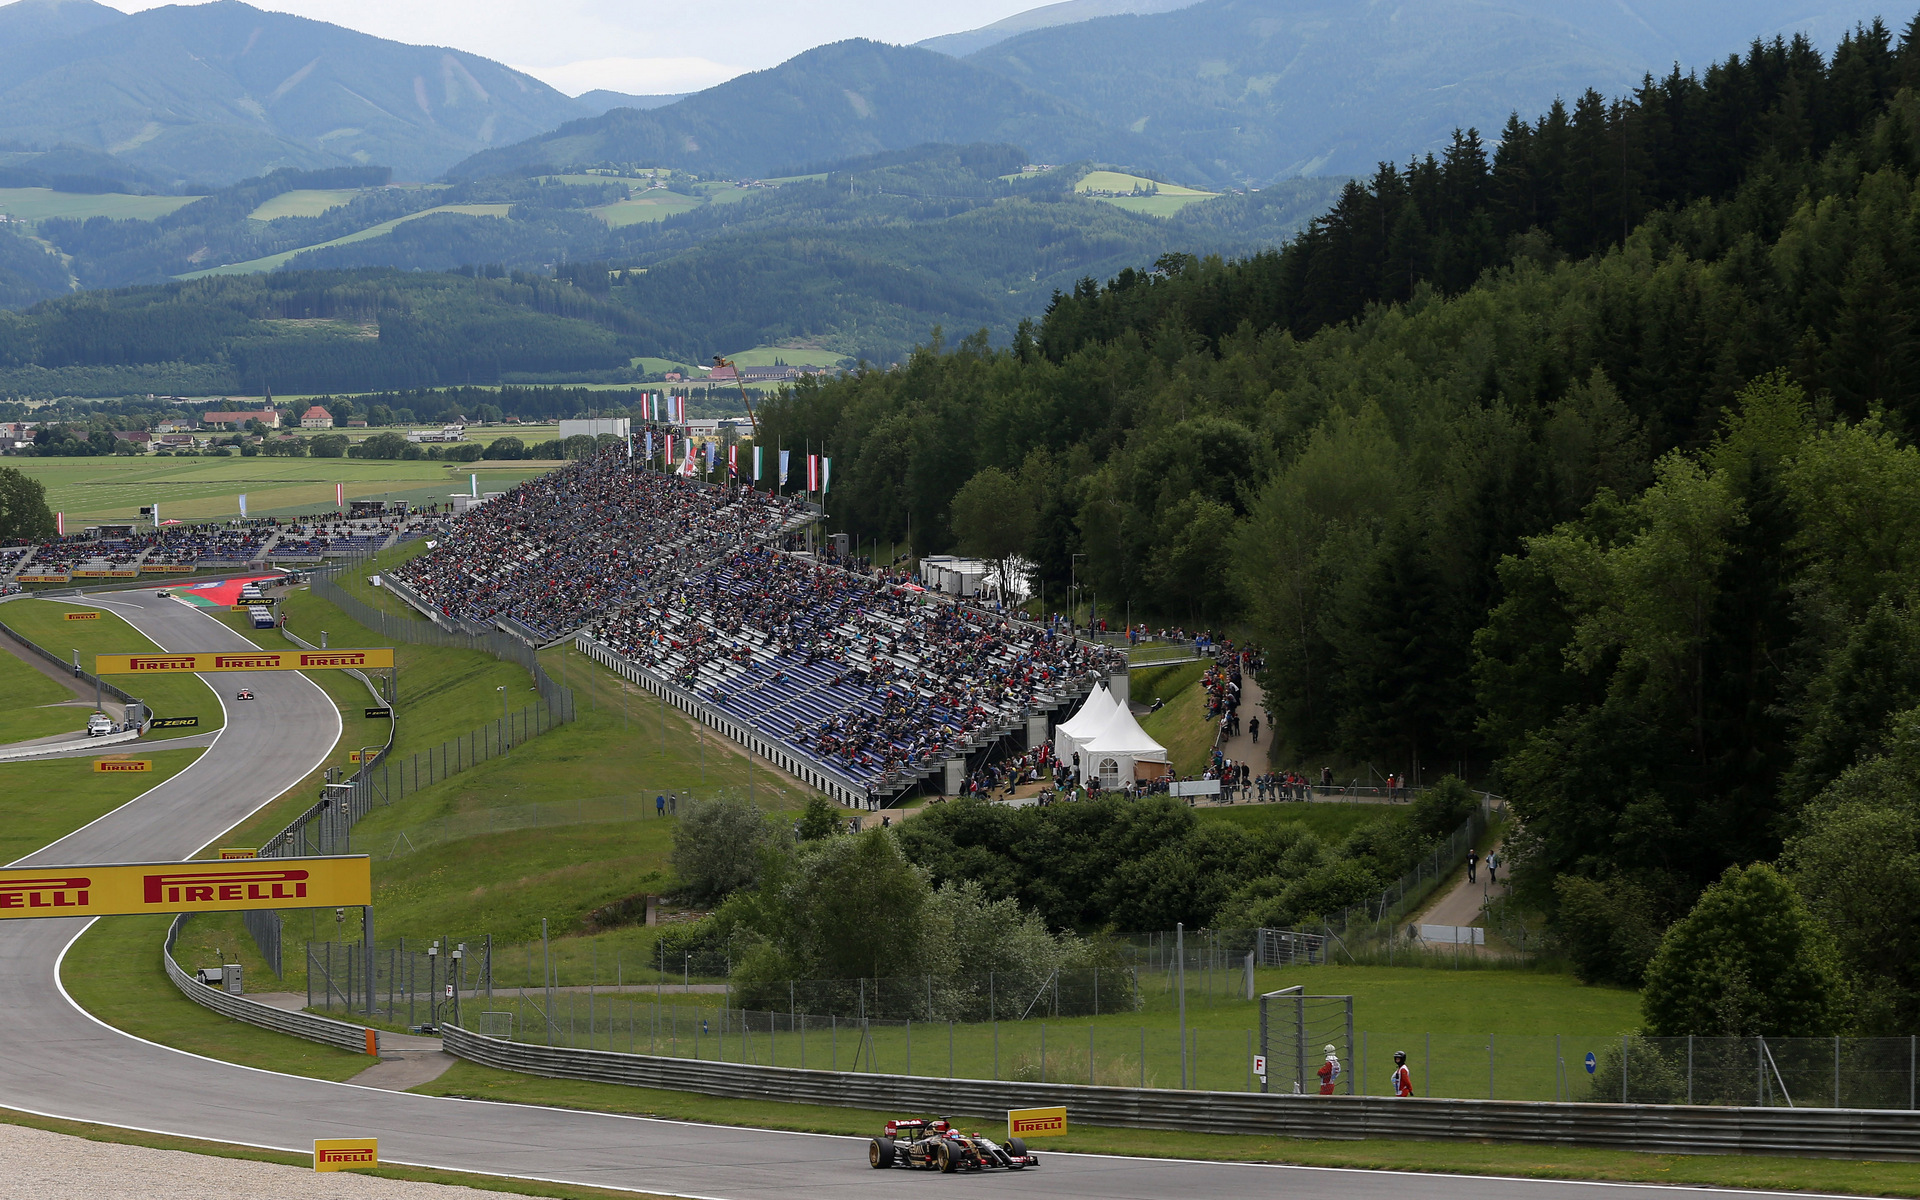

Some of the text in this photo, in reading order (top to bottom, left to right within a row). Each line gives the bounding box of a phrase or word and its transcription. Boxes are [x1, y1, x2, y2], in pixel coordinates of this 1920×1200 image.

[130, 653, 365, 670] PIRELLI PIRELLI PIRELLI
[101, 762, 144, 771] PIRELLI
[0, 869, 309, 908] ELLI PIRELLI
[1256, 1059, 1263, 1071] F
[1013, 1116, 1063, 1132] PIRELLI
[319, 1149, 374, 1163] PIRELLI
